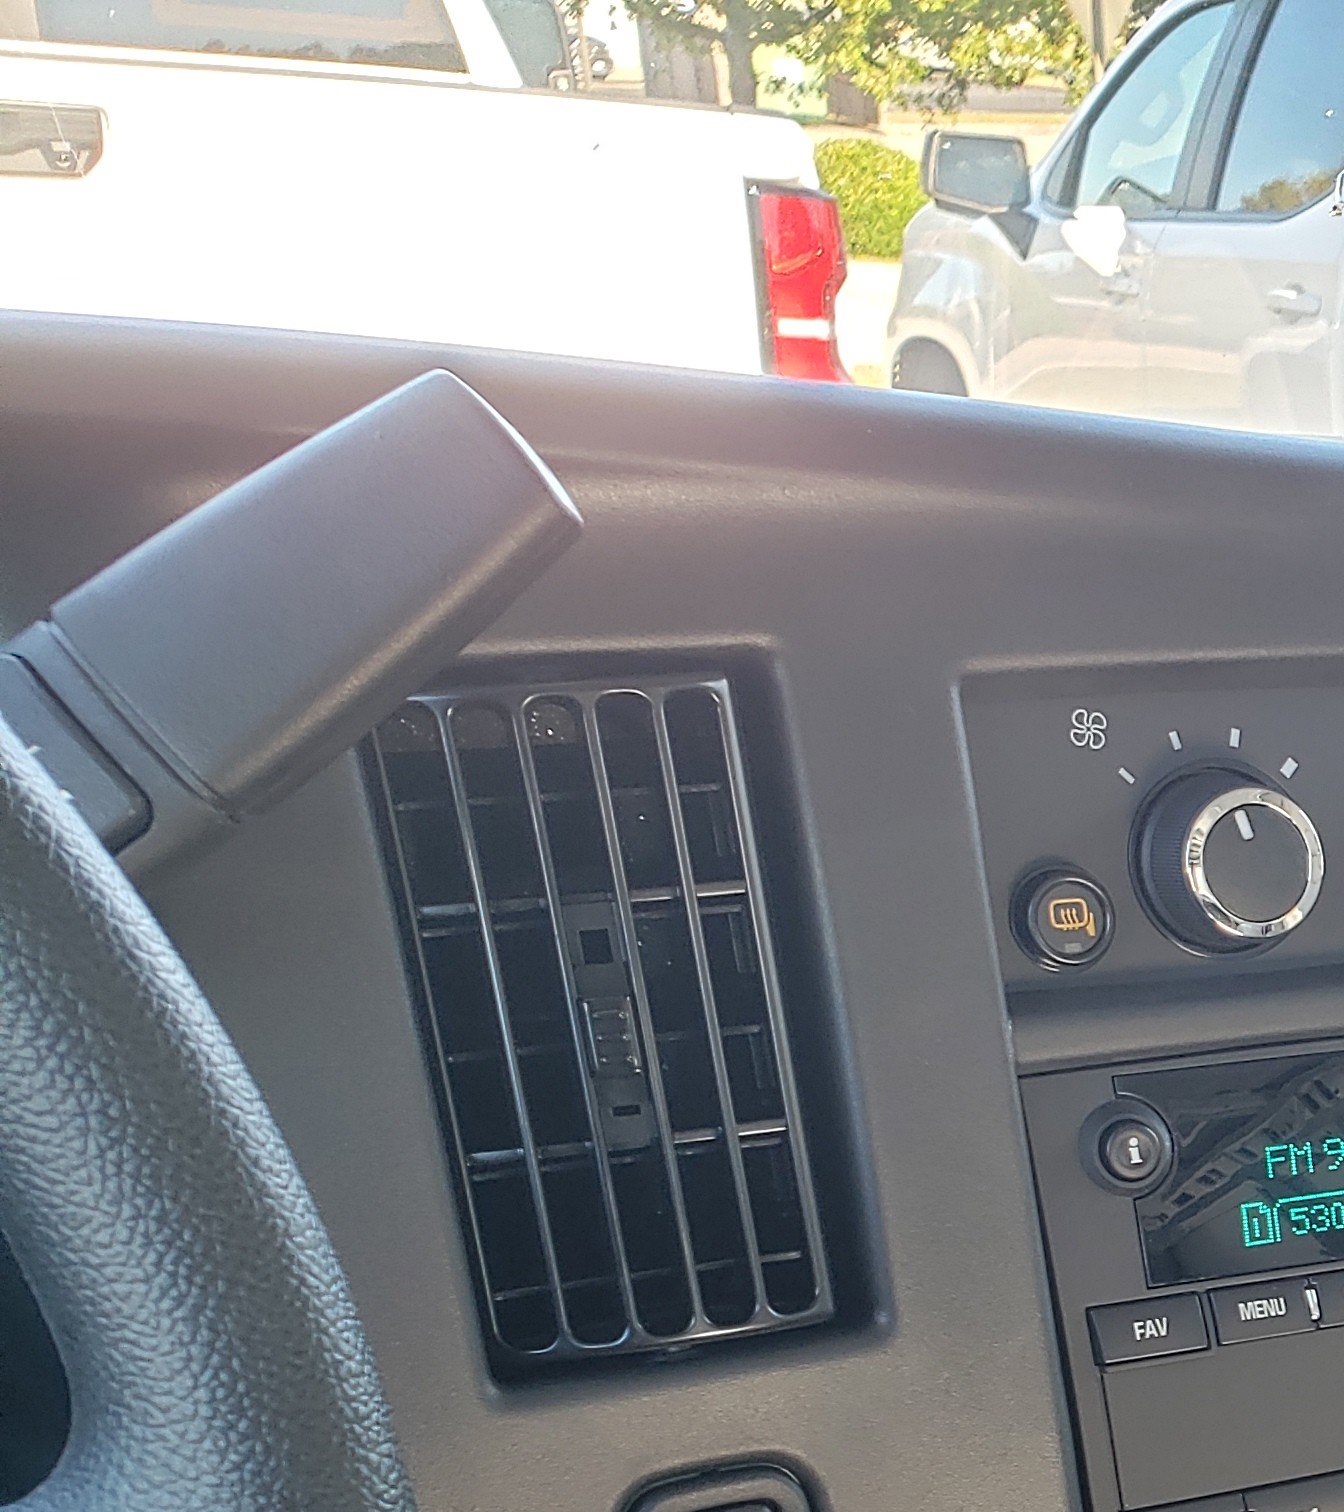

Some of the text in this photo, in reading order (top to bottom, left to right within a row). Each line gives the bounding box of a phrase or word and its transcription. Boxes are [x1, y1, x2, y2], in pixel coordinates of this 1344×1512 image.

[1264, 1140, 1315, 1179] FM
[1237, 1297, 1287, 1321] MENU
[1132, 1316, 1168, 1341] FAV
